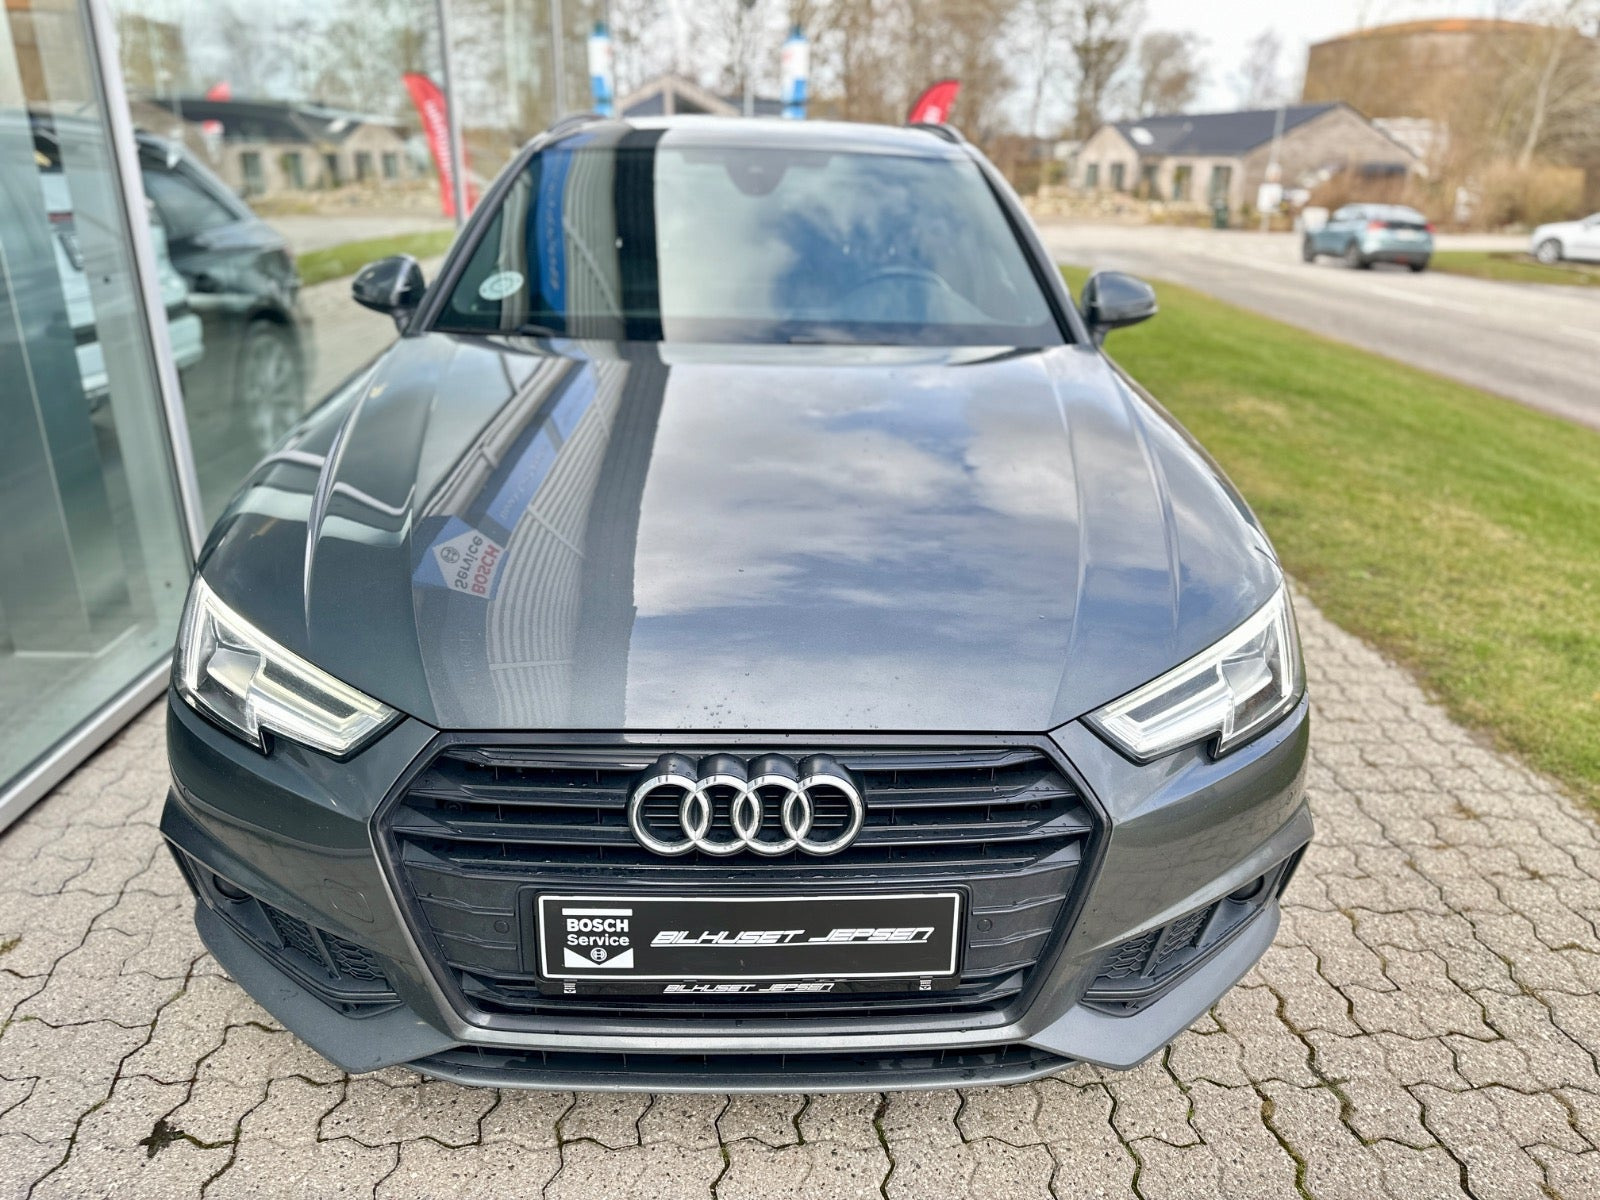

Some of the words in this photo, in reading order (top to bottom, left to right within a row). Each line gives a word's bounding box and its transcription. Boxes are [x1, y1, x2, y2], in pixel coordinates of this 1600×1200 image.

[566, 918, 630, 933] BOSCH
[566, 933, 630, 946] Service
[650, 930, 806, 946] BILHUSET
[807, 926, 935, 942] JEPSEN
[663, 984, 757, 993] BILHUSET
[758, 983, 836, 993] JEPSEN
